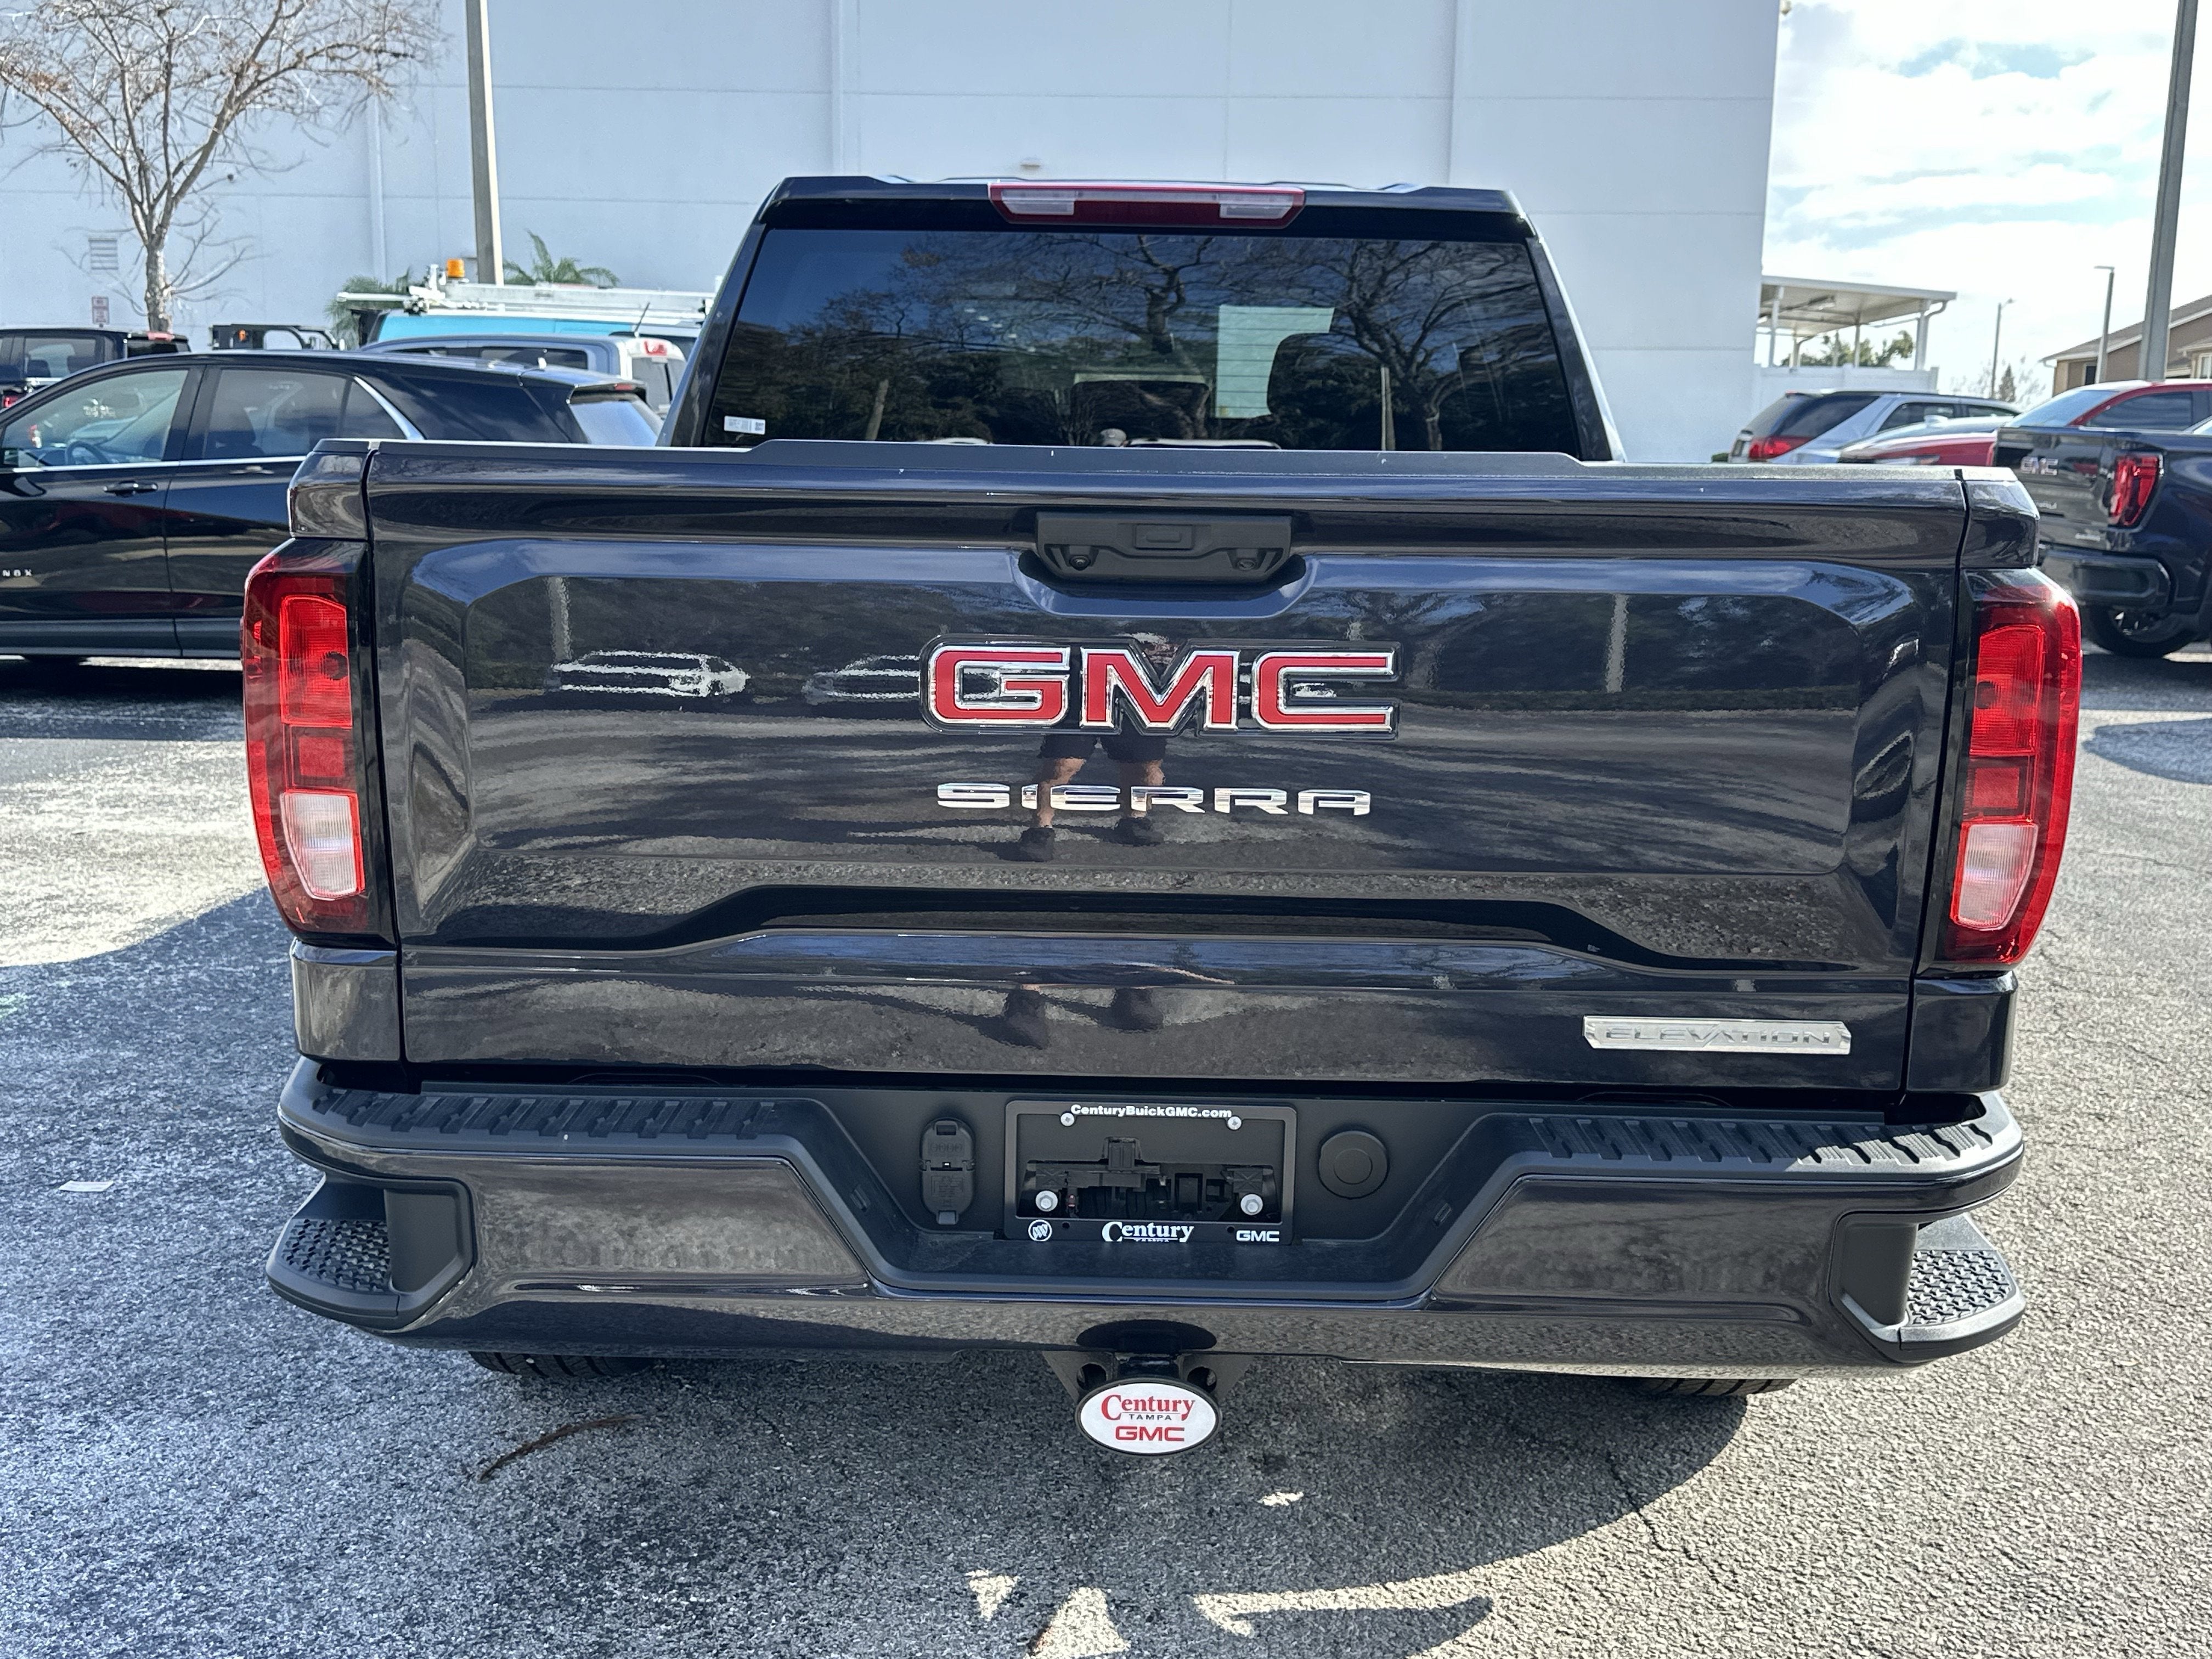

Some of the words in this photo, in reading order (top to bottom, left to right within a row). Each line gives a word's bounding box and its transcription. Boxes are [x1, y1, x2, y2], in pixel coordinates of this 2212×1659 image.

[930, 646, 1395, 733] GMC
[937, 782, 1371, 816] SIERRA
[1606, 1023, 1830, 1046] ELEVATION
[1070, 1104, 1232, 1118] CenturyBuickGMC.com
[1102, 1221, 1194, 1243] Century
[1236, 1230, 1279, 1242] GMC
[1101, 1395, 1195, 1421] Century
[1115, 1426, 1184, 1442] GMC
